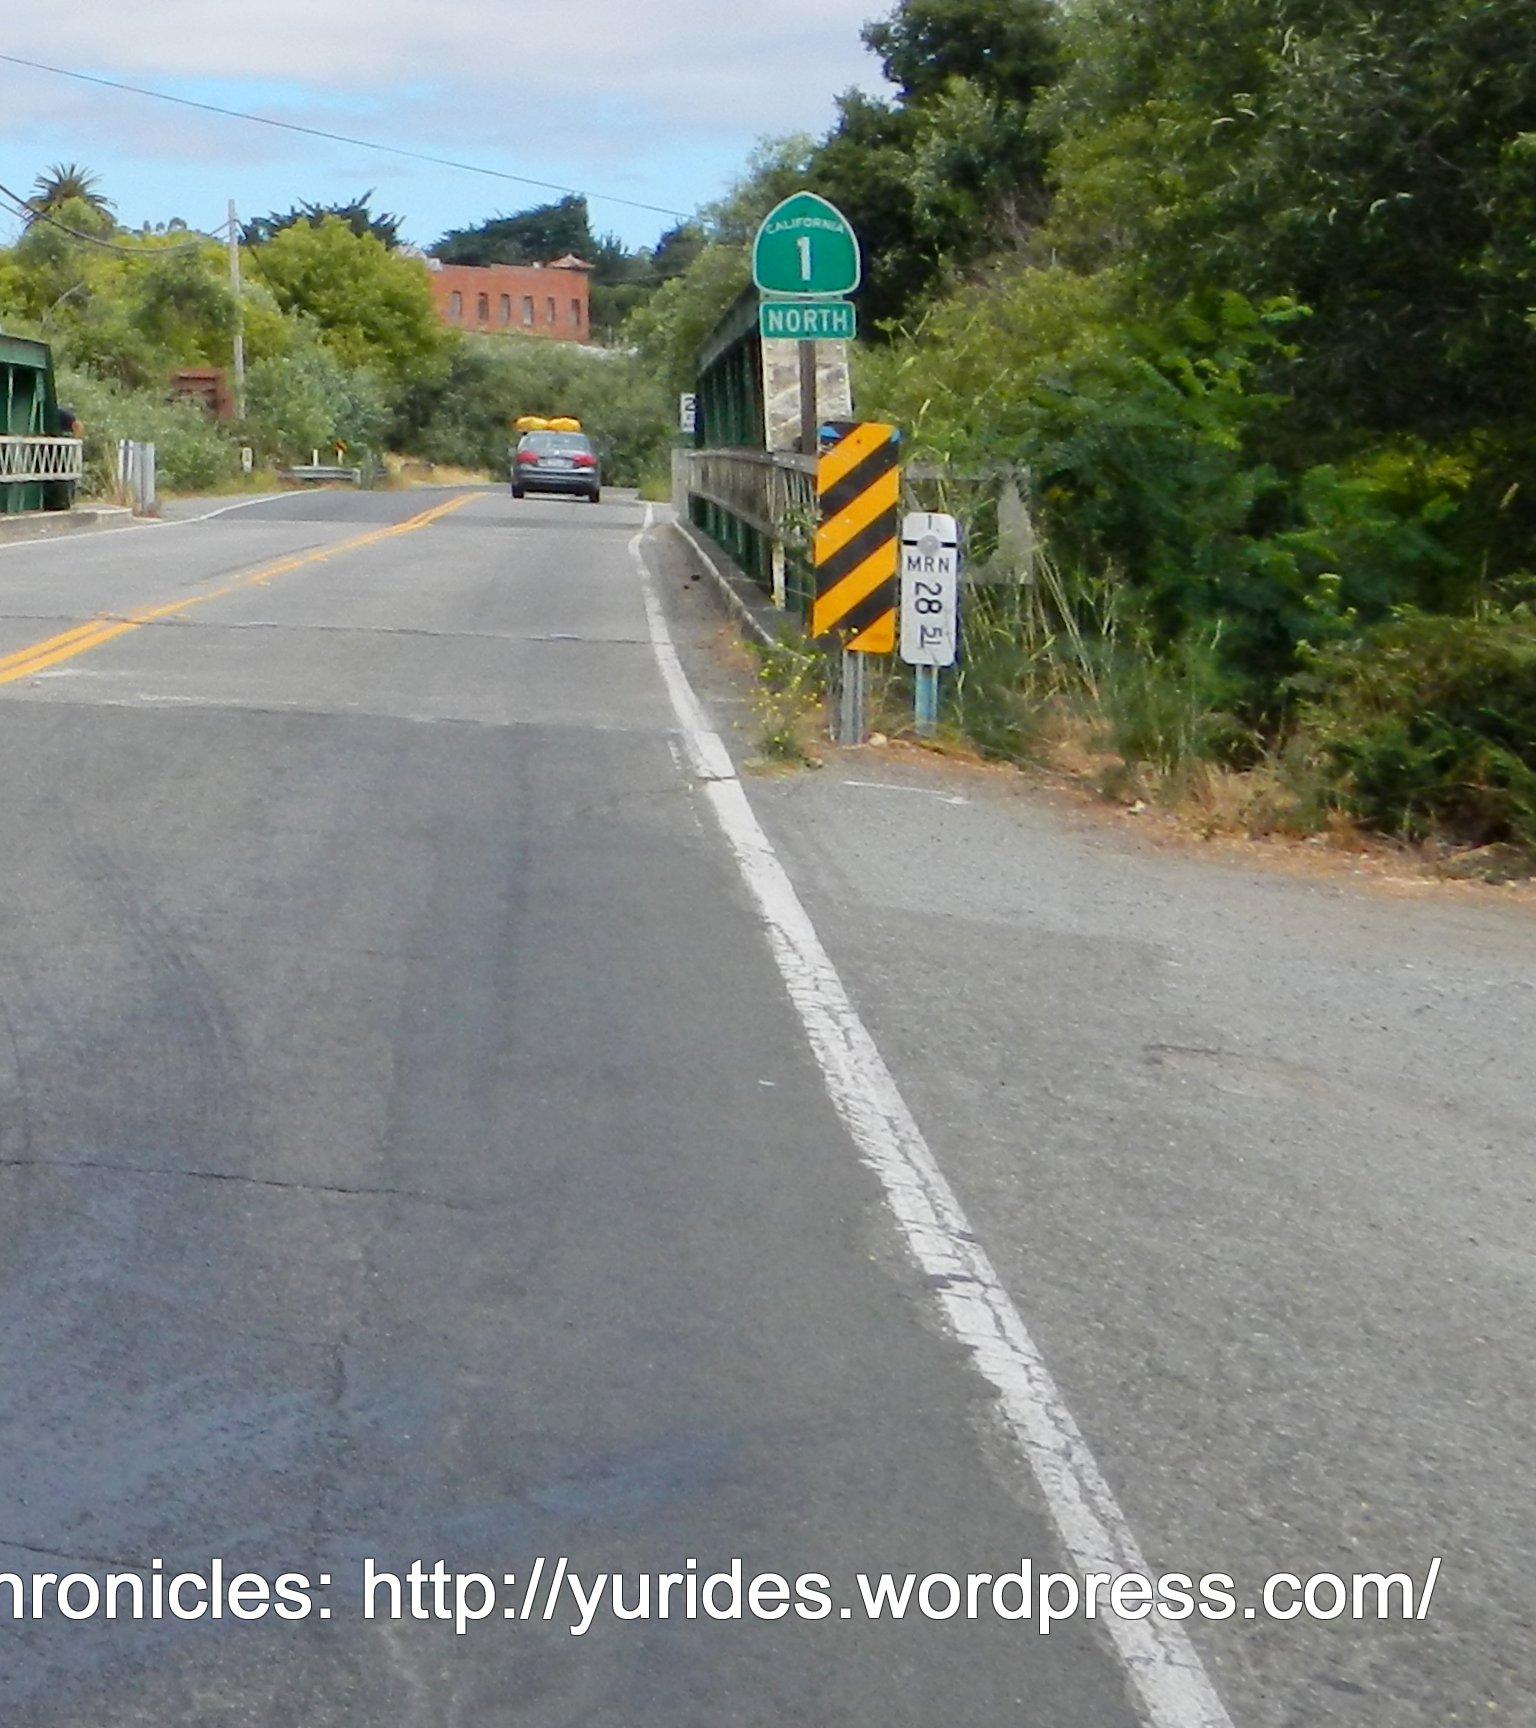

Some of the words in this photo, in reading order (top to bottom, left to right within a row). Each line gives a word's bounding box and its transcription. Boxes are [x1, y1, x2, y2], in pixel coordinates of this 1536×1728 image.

[766, 217, 845, 235] CALIFORNIA
[796, 236, 812, 281] 1
[767, 308, 849, 332] NORTH
[906, 556, 950, 574] MRN
[914, 581, 943, 615] 28
